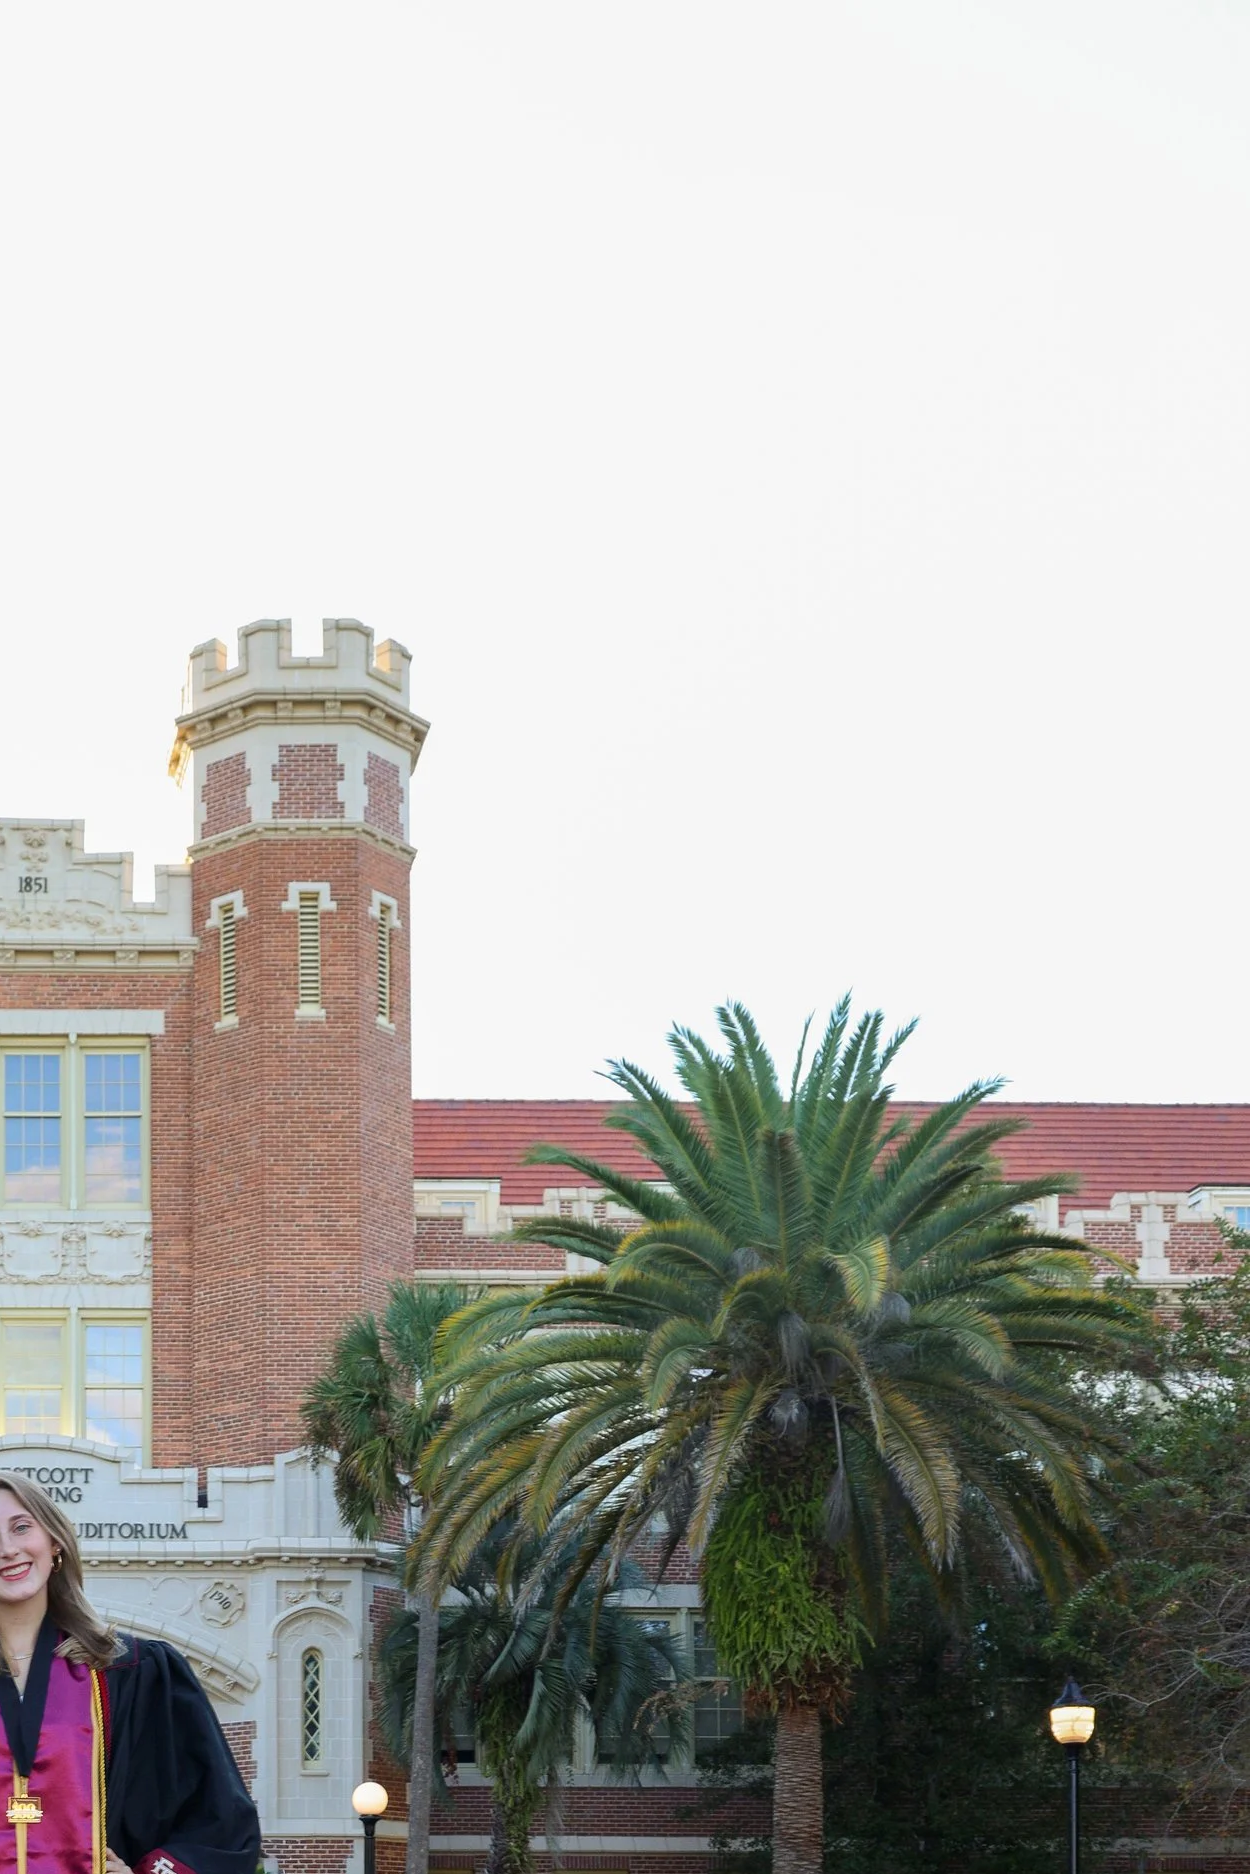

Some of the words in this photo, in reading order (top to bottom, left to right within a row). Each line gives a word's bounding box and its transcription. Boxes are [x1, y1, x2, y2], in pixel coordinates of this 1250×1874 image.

[18, 876, 49, 893] 1851
[72, 1522, 188, 1539] UDITORIUM
[209, 1590, 232, 1610] 1910
